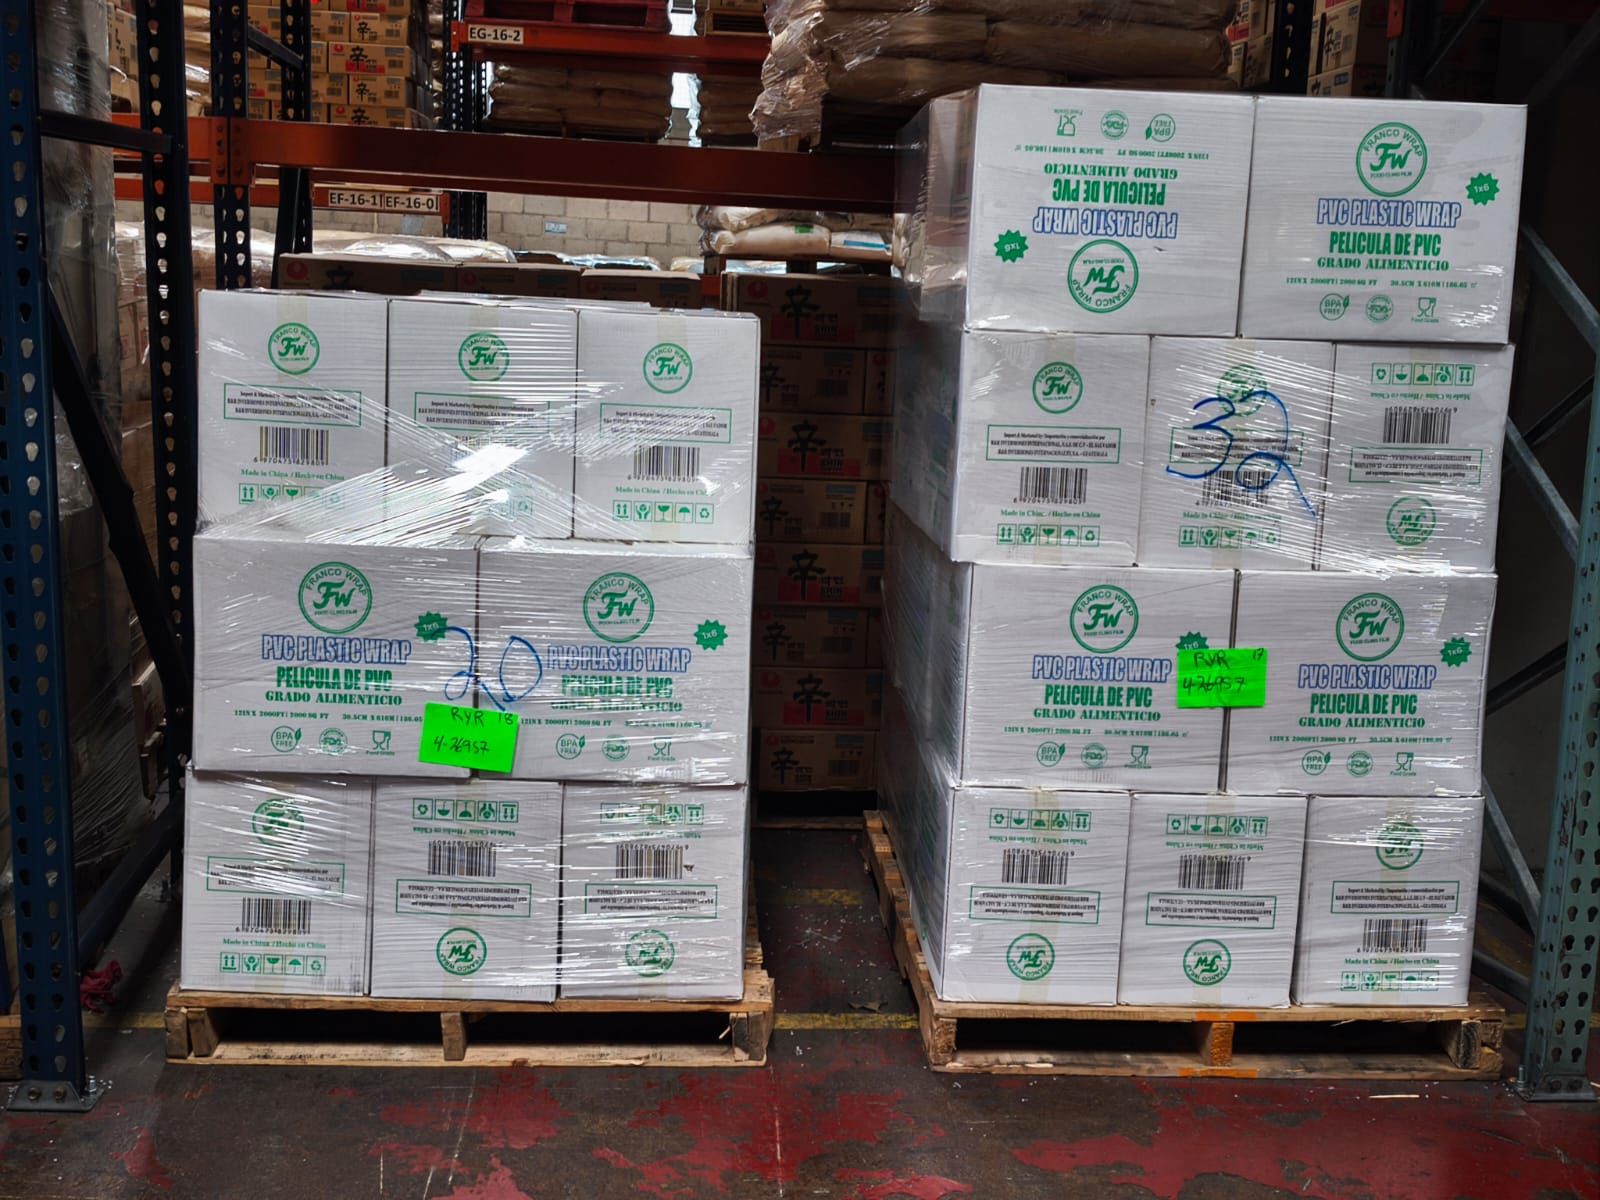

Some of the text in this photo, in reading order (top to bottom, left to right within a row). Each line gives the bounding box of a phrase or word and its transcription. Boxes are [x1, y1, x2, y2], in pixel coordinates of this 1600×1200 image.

[470, 27, 520, 42] EG-16-2
[1154, 128, 1171, 136] BPA
[1364, 129, 1423, 157] FRANCO WRAP
[1044, 163, 1178, 179] GRADO ALIMENTICIO
[330, 192, 378, 206] EF-16-1
[386, 196, 434, 210] EF-16-0
[1053, 178, 1166, 205] PELICULA DE PVC
[1033, 206, 1178, 238] PVC PLASTIC WRAP
[1317, 198, 1462, 228] PVC PLASTIC WRAP
[1329, 231, 1441, 256] PELICULA DE PVC
[1317, 258, 1449, 271] GRADO ALIMENTICIO
[1072, 278, 1131, 307] FRANCO WRAP
[1325, 299, 1341, 307] BPA
[787, 420, 827, 472] 辛
[306, 568, 367, 596] FRANCO WRAP
[788, 549, 826, 600] 辛
[589, 579, 649, 605] FRANCO WRAP
[1077, 590, 1134, 617] FRANCO WRAP
[1344, 600, 1399, 624] FRANCO WRAP
[262, 634, 411, 664] PVC PLASTIC WRAP
[548, 644, 692, 673] PVC PLASTIC WRAP
[276, 666, 392, 692] PELICULA DE PVC
[1032, 654, 1172, 683] PVC PLASTIC WRAP
[1298, 664, 1436, 689] PVC PLASTIC WRAP
[265, 691, 402, 705] GRADO ALIMENTICIO
[626, 676, 644, 698] DE
[646, 676, 674, 698] PVC
[793, 674, 831, 722] 辛
[1045, 684, 1152, 707] PELICULA DE PVC
[1033, 708, 1161, 721] GRADO ALIMENTICIO
[1310, 693, 1417, 715] PELICULA DE PVC
[1299, 718, 1425, 728] GRADO ALIMENTICIO
[276, 732, 293, 740] BPA
[561, 739, 578, 747] BPA
[1041, 745, 1057, 753] BPA
